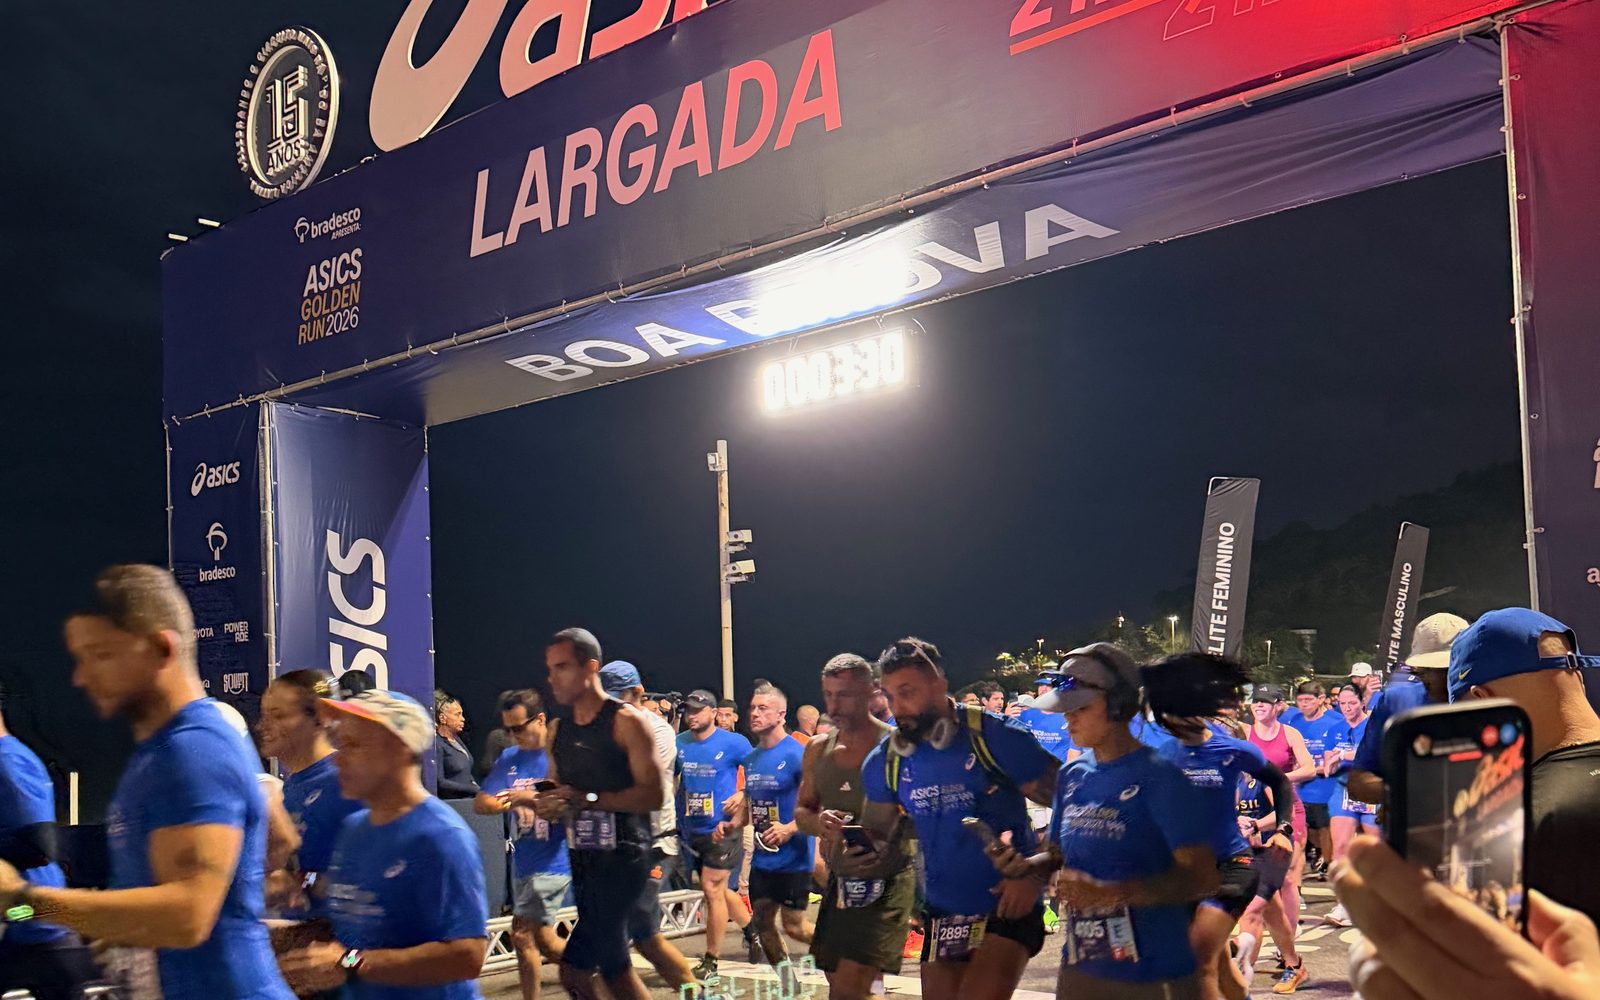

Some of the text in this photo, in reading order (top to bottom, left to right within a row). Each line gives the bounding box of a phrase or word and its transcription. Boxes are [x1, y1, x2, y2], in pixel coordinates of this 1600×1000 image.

[266, 65, 308, 145] 15
[266, 139, 303, 174] ANOS
[470, 29, 842, 257] LARGADA
[311, 207, 361, 239] bradesco
[303, 247, 363, 297] ASICS
[301, 281, 361, 321] GOLDEN
[504, 203, 1120, 382] BOA PVA
[298, 306, 360, 345] RUN 2026
[207, 461, 241, 488] asics
[199, 565, 236, 582] bradesco
[1211, 522, 1236, 611] FEMININO
[326, 529, 389, 692] SICS
[1391, 562, 1413, 639] MASCULINO
[191, 627, 214, 639] OYOTA
[224, 621, 249, 633] POWER
[910, 785, 940, 800] ASICS
[1235, 799, 1260, 810] SIL
[939, 925, 969, 941] 2895
